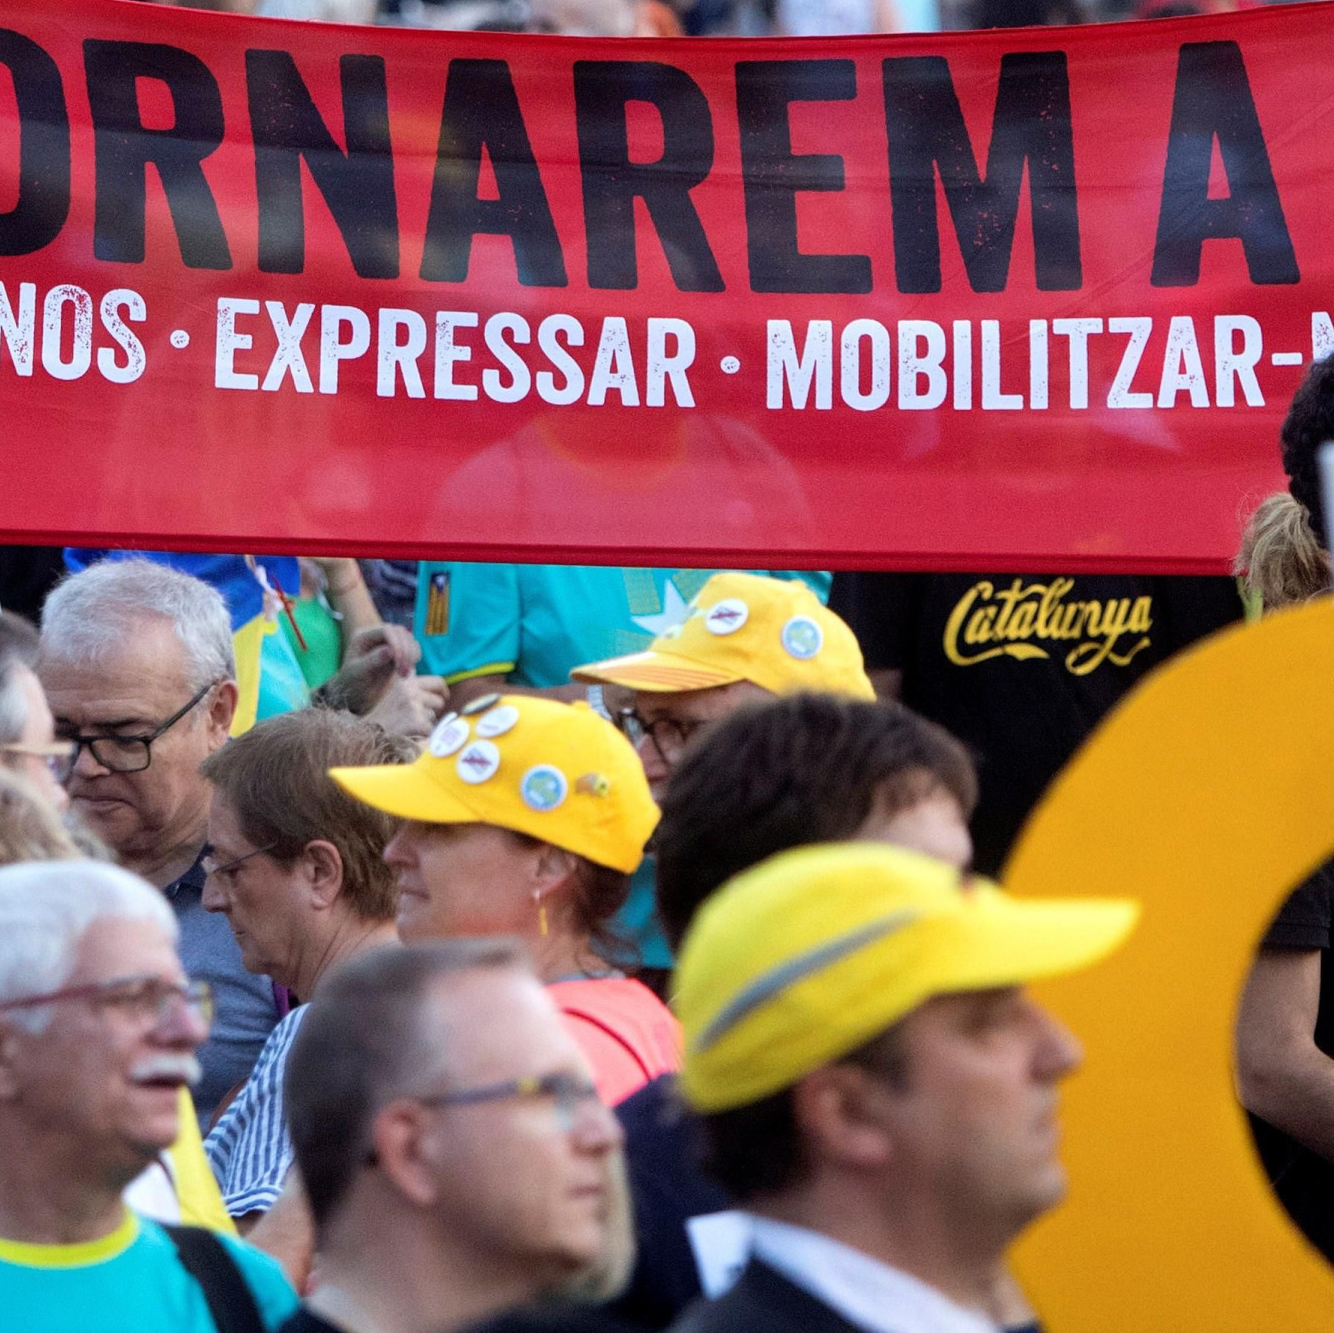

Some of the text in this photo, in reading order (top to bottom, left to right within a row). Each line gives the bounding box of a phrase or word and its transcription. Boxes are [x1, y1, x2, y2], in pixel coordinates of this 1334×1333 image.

[1150, 39, 1301, 287] A
[214, 296, 696, 408] EXPRESSAR
[942, 575, 1154, 677] Catalunya
